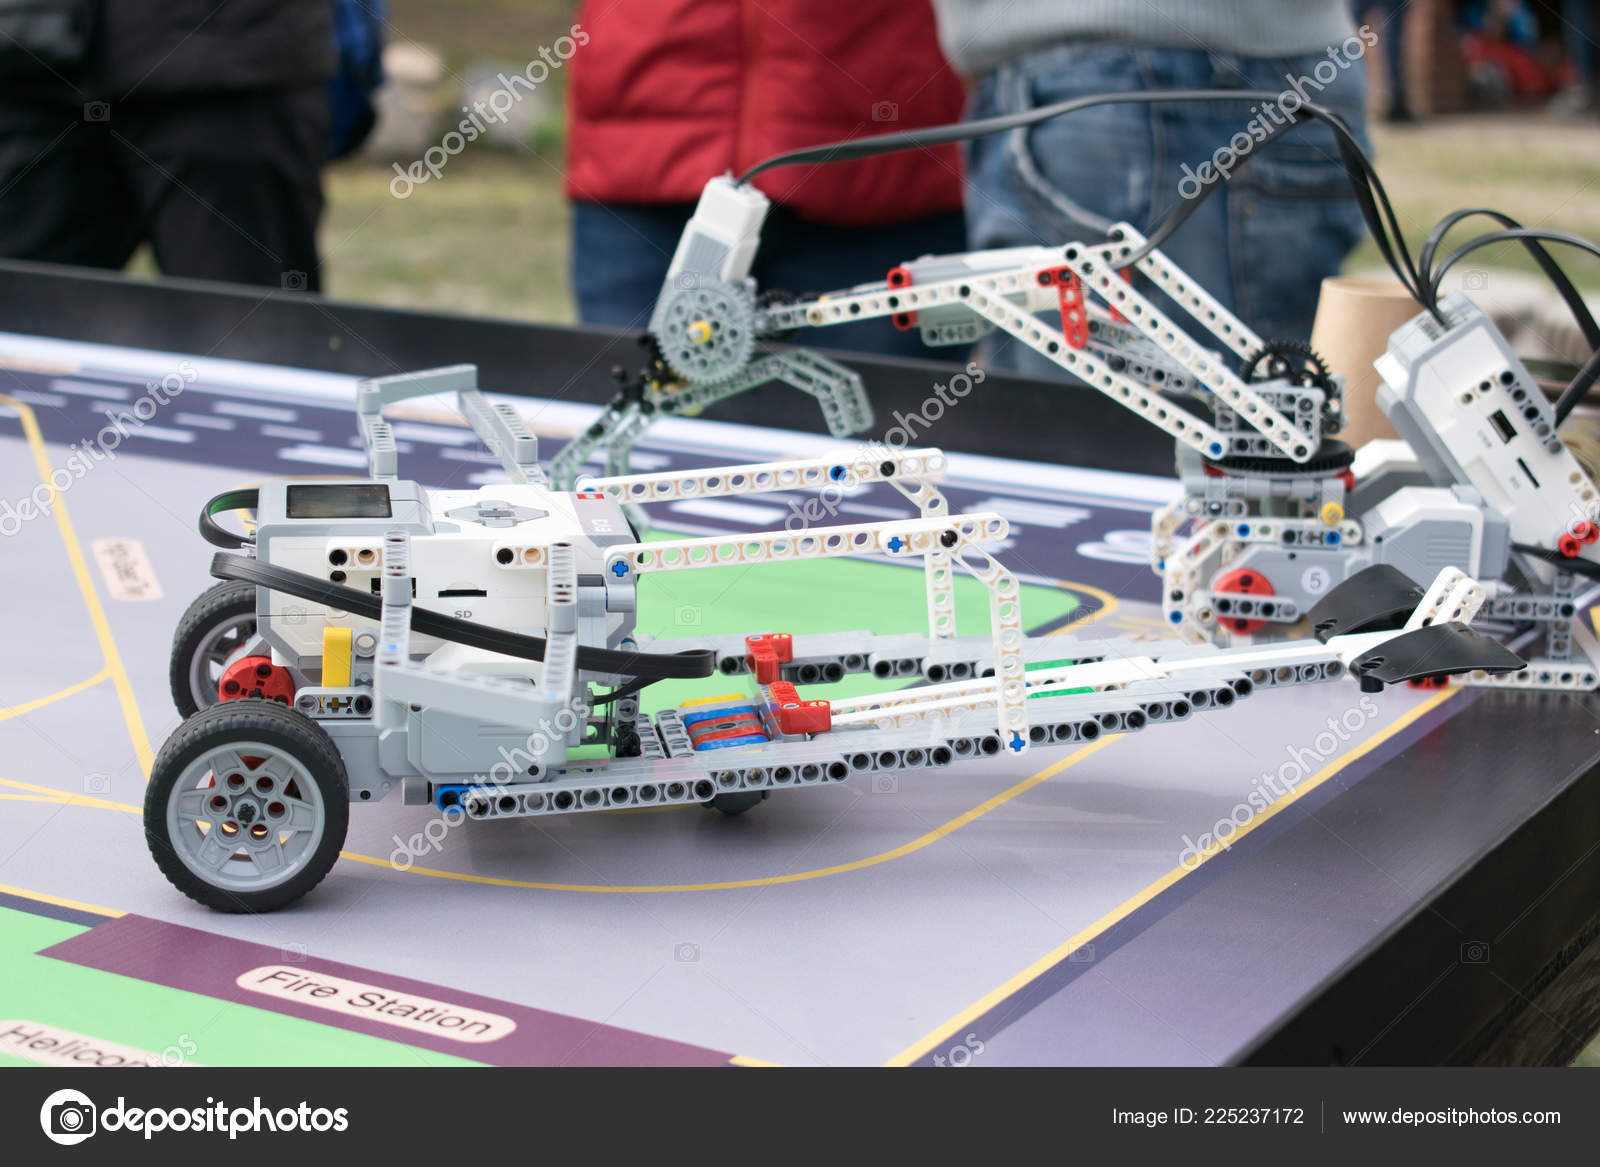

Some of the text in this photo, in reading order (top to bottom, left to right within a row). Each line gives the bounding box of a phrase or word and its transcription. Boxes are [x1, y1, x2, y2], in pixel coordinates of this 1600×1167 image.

[1310, 572, 1322, 589] 5
[454, 610, 473, 619] SD
[257, 970, 491, 1035] Fire Station
